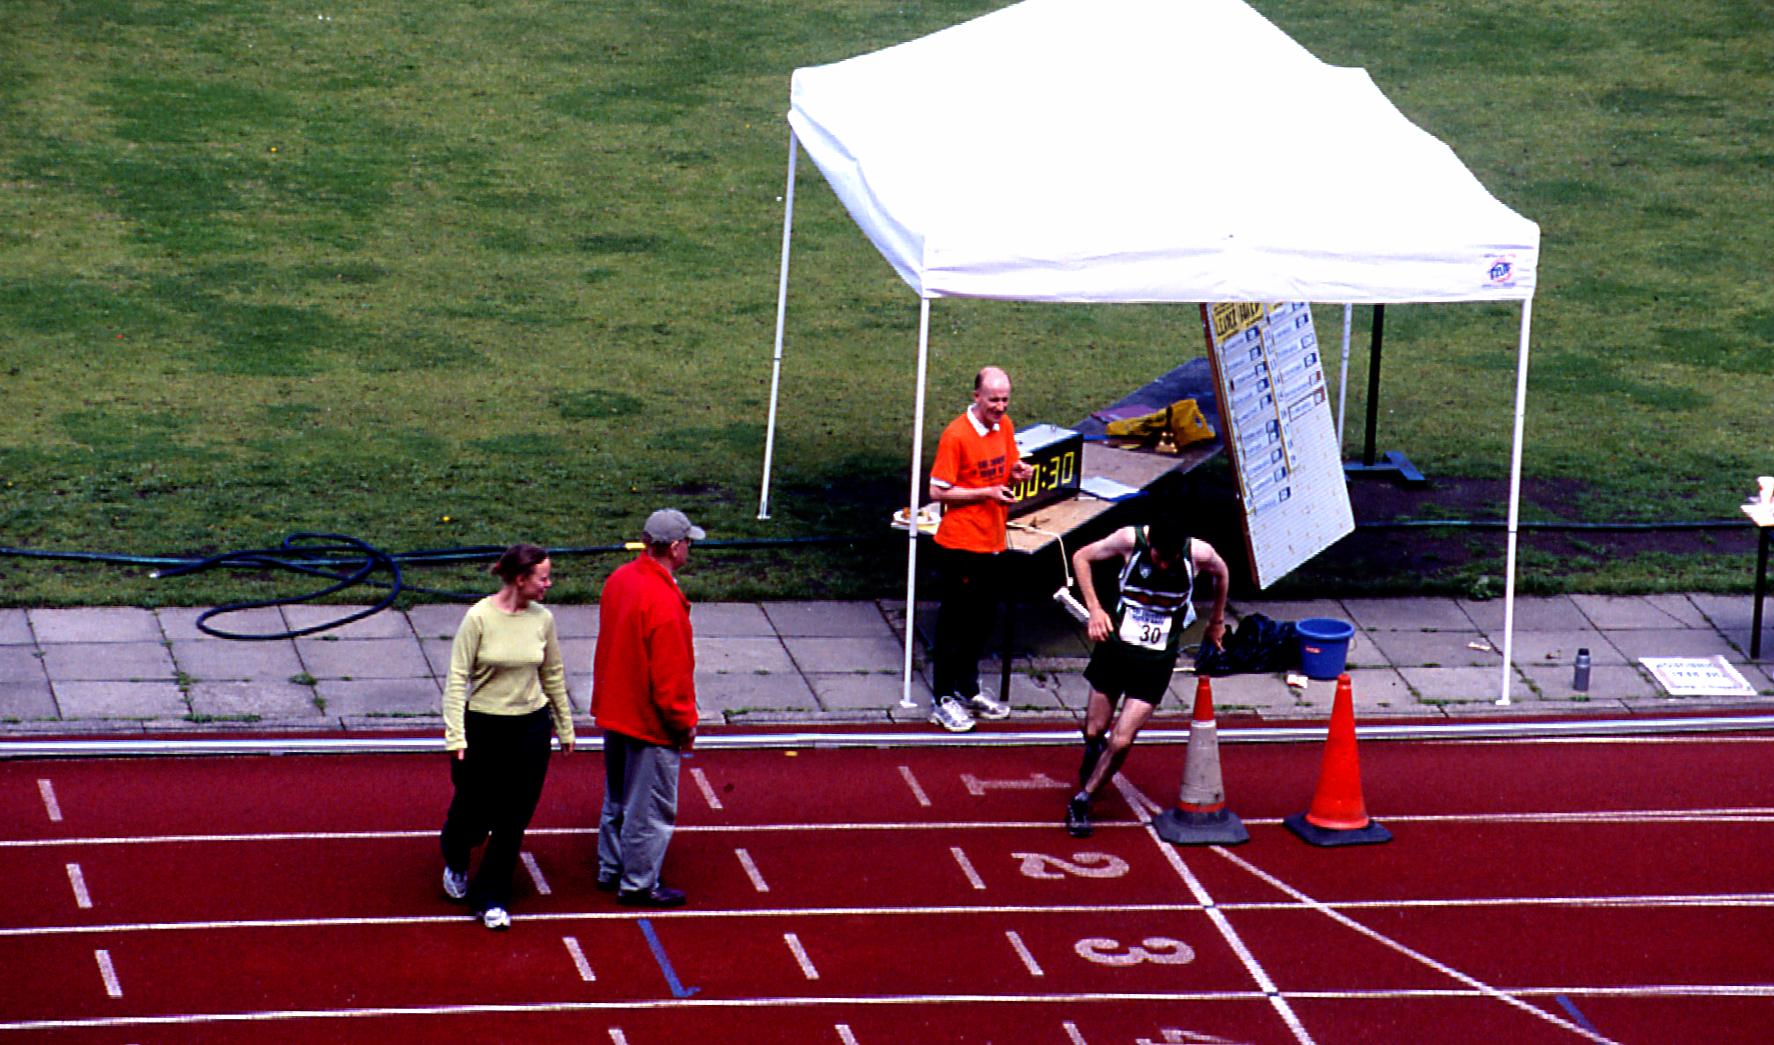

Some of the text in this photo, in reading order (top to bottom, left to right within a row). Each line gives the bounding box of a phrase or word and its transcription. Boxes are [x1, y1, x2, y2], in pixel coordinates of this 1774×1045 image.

[1139, 624, 1162, 645] 30
[960, 772, 1072, 796] 1
[1010, 850, 1130, 880] 2
[1073, 936, 1196, 967] 3
